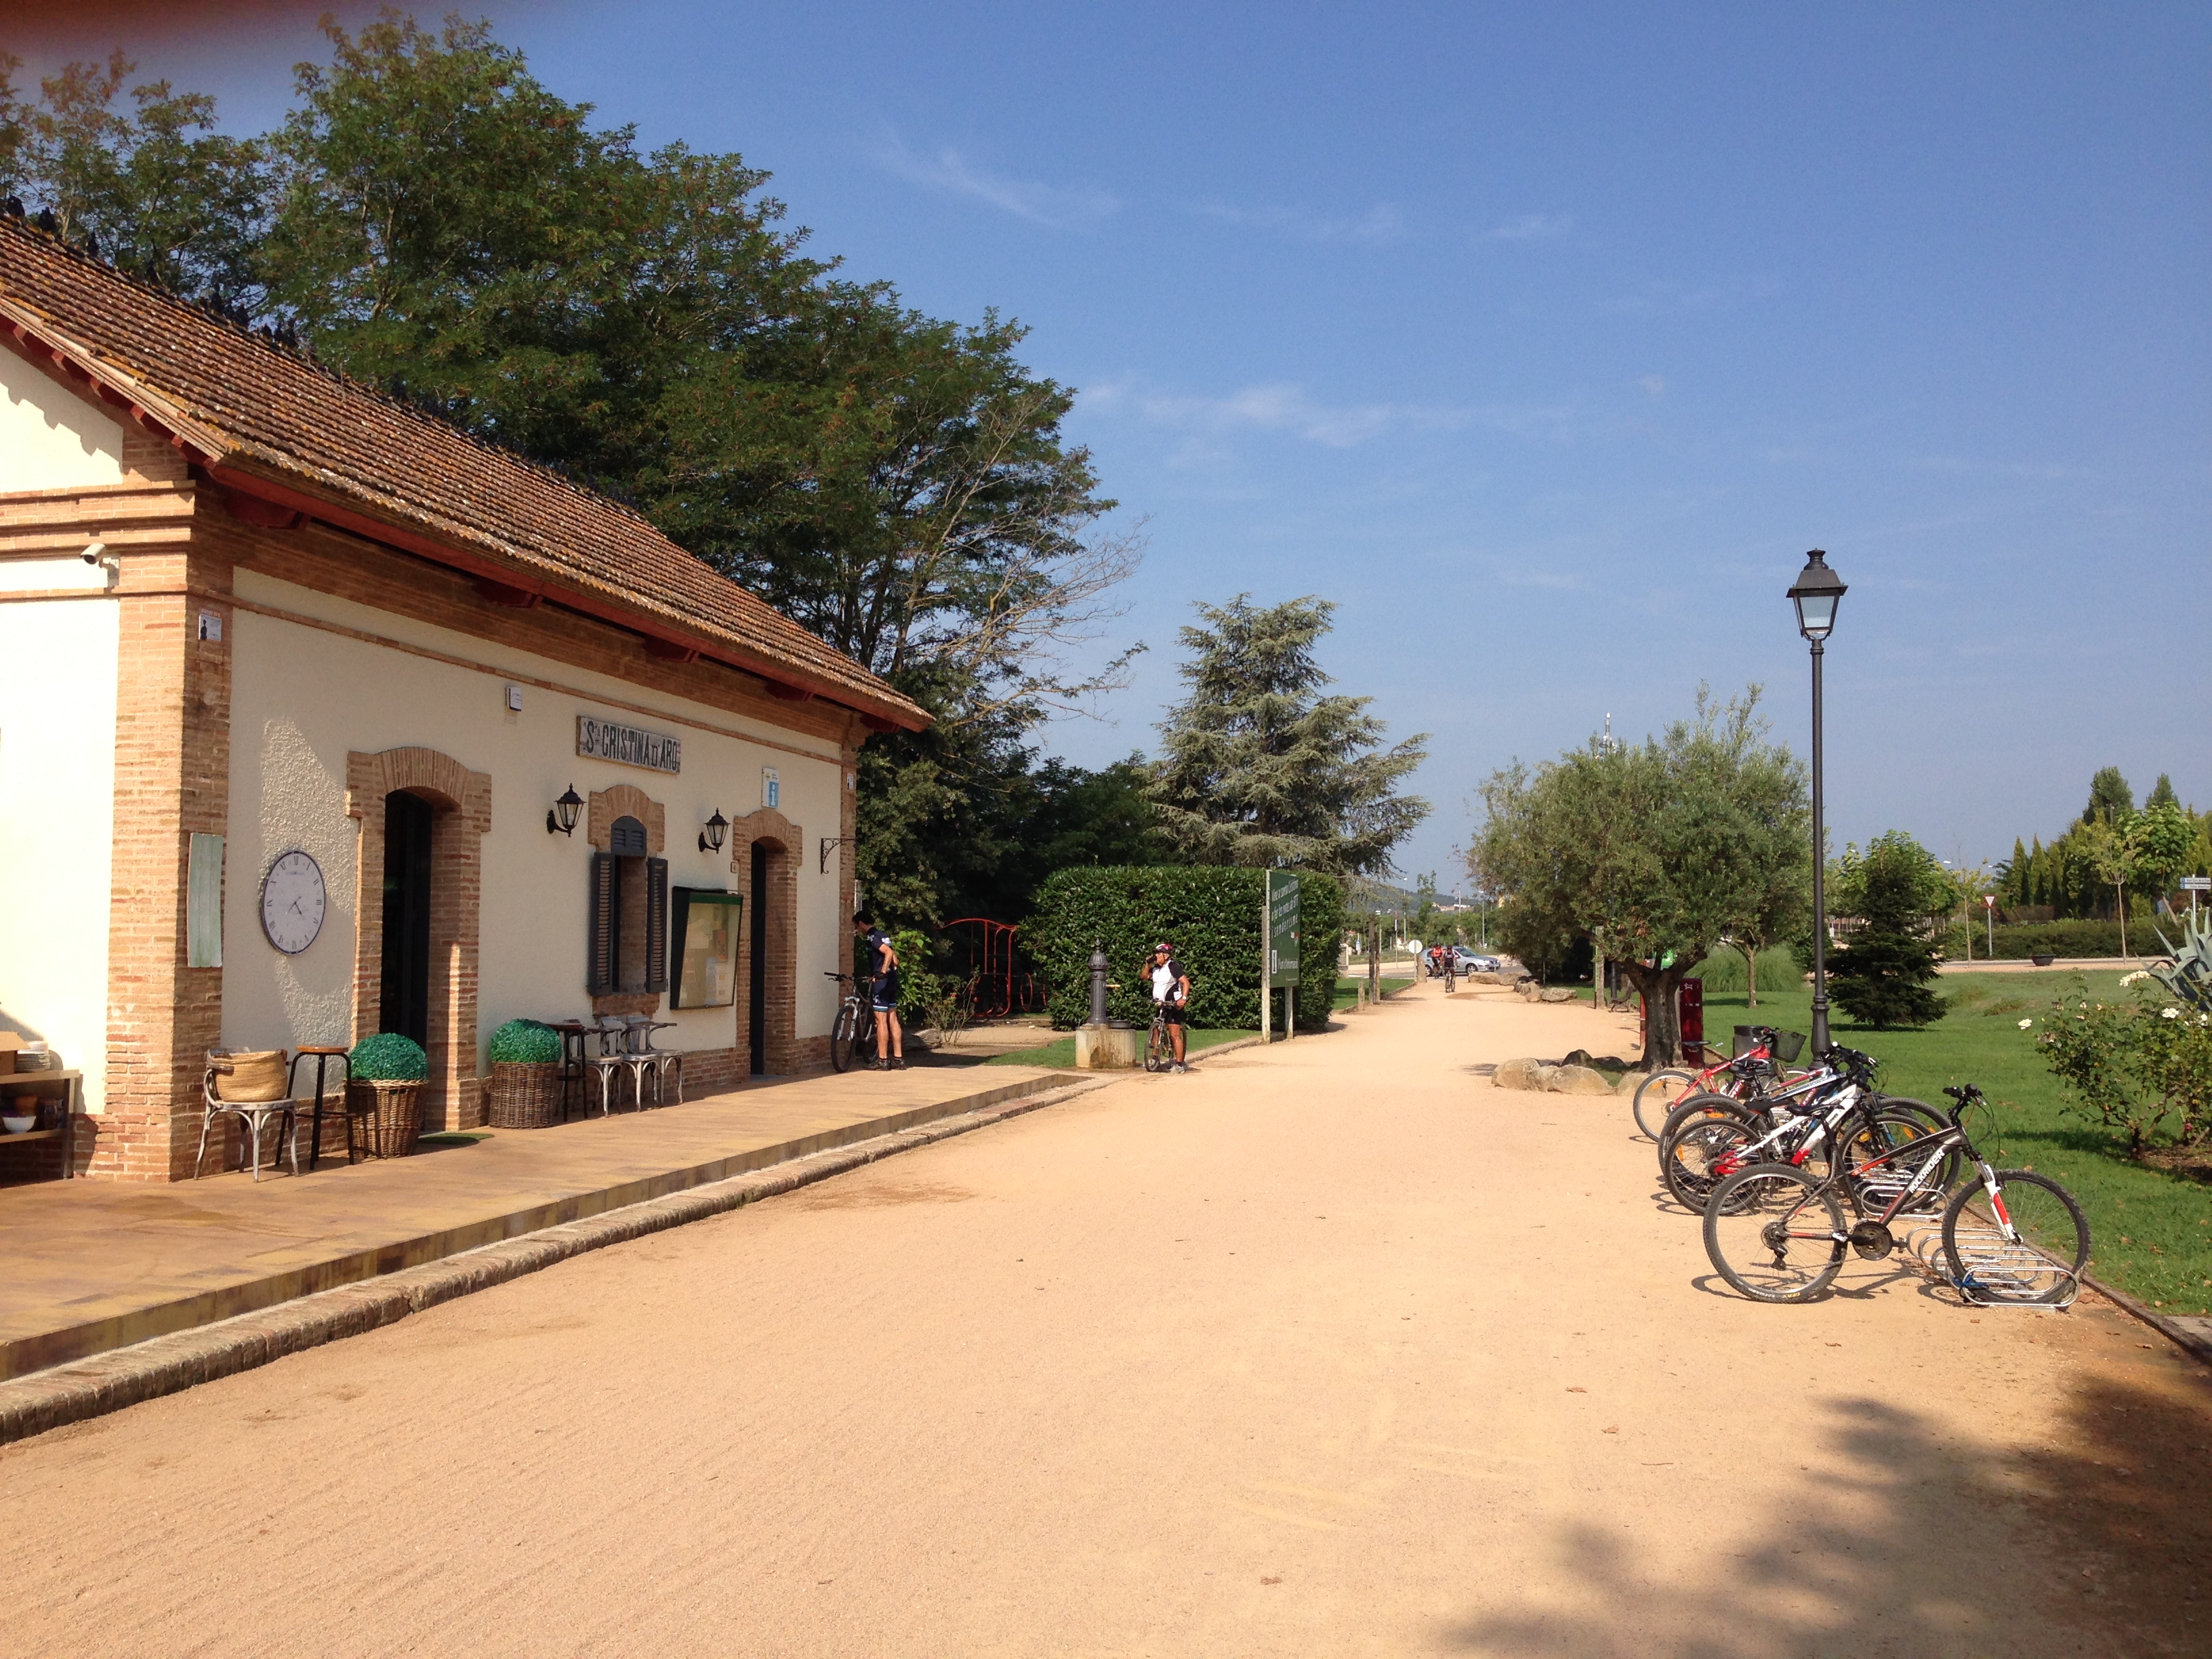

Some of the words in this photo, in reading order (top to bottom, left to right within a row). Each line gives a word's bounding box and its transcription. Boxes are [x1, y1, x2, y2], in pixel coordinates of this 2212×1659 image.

[602, 724, 650, 766] CRISTINA
[1274, 913, 1298, 938] senderisme
[1908, 1148, 1945, 1193] ROCKRIDER
